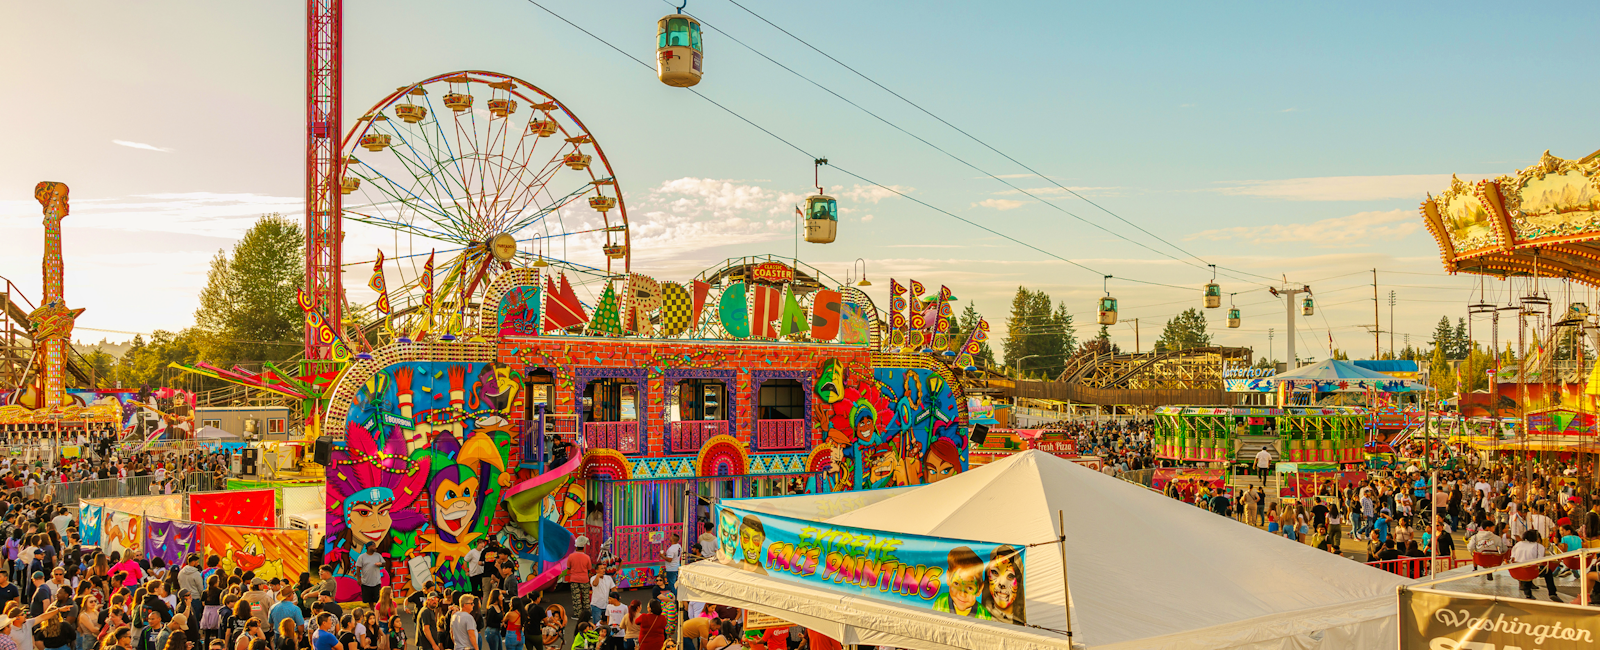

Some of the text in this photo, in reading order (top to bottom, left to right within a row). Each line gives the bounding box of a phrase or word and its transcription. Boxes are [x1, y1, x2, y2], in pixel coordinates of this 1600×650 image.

[754, 268, 792, 278] COASTER
[540, 271, 843, 343] MARDI GRAS
[1037, 441, 1072, 451] Fresh Pizza
[799, 526, 904, 561] EXTREME
[765, 540, 944, 600] FACE PAINTING
[1435, 608, 1593, 645] Washington
